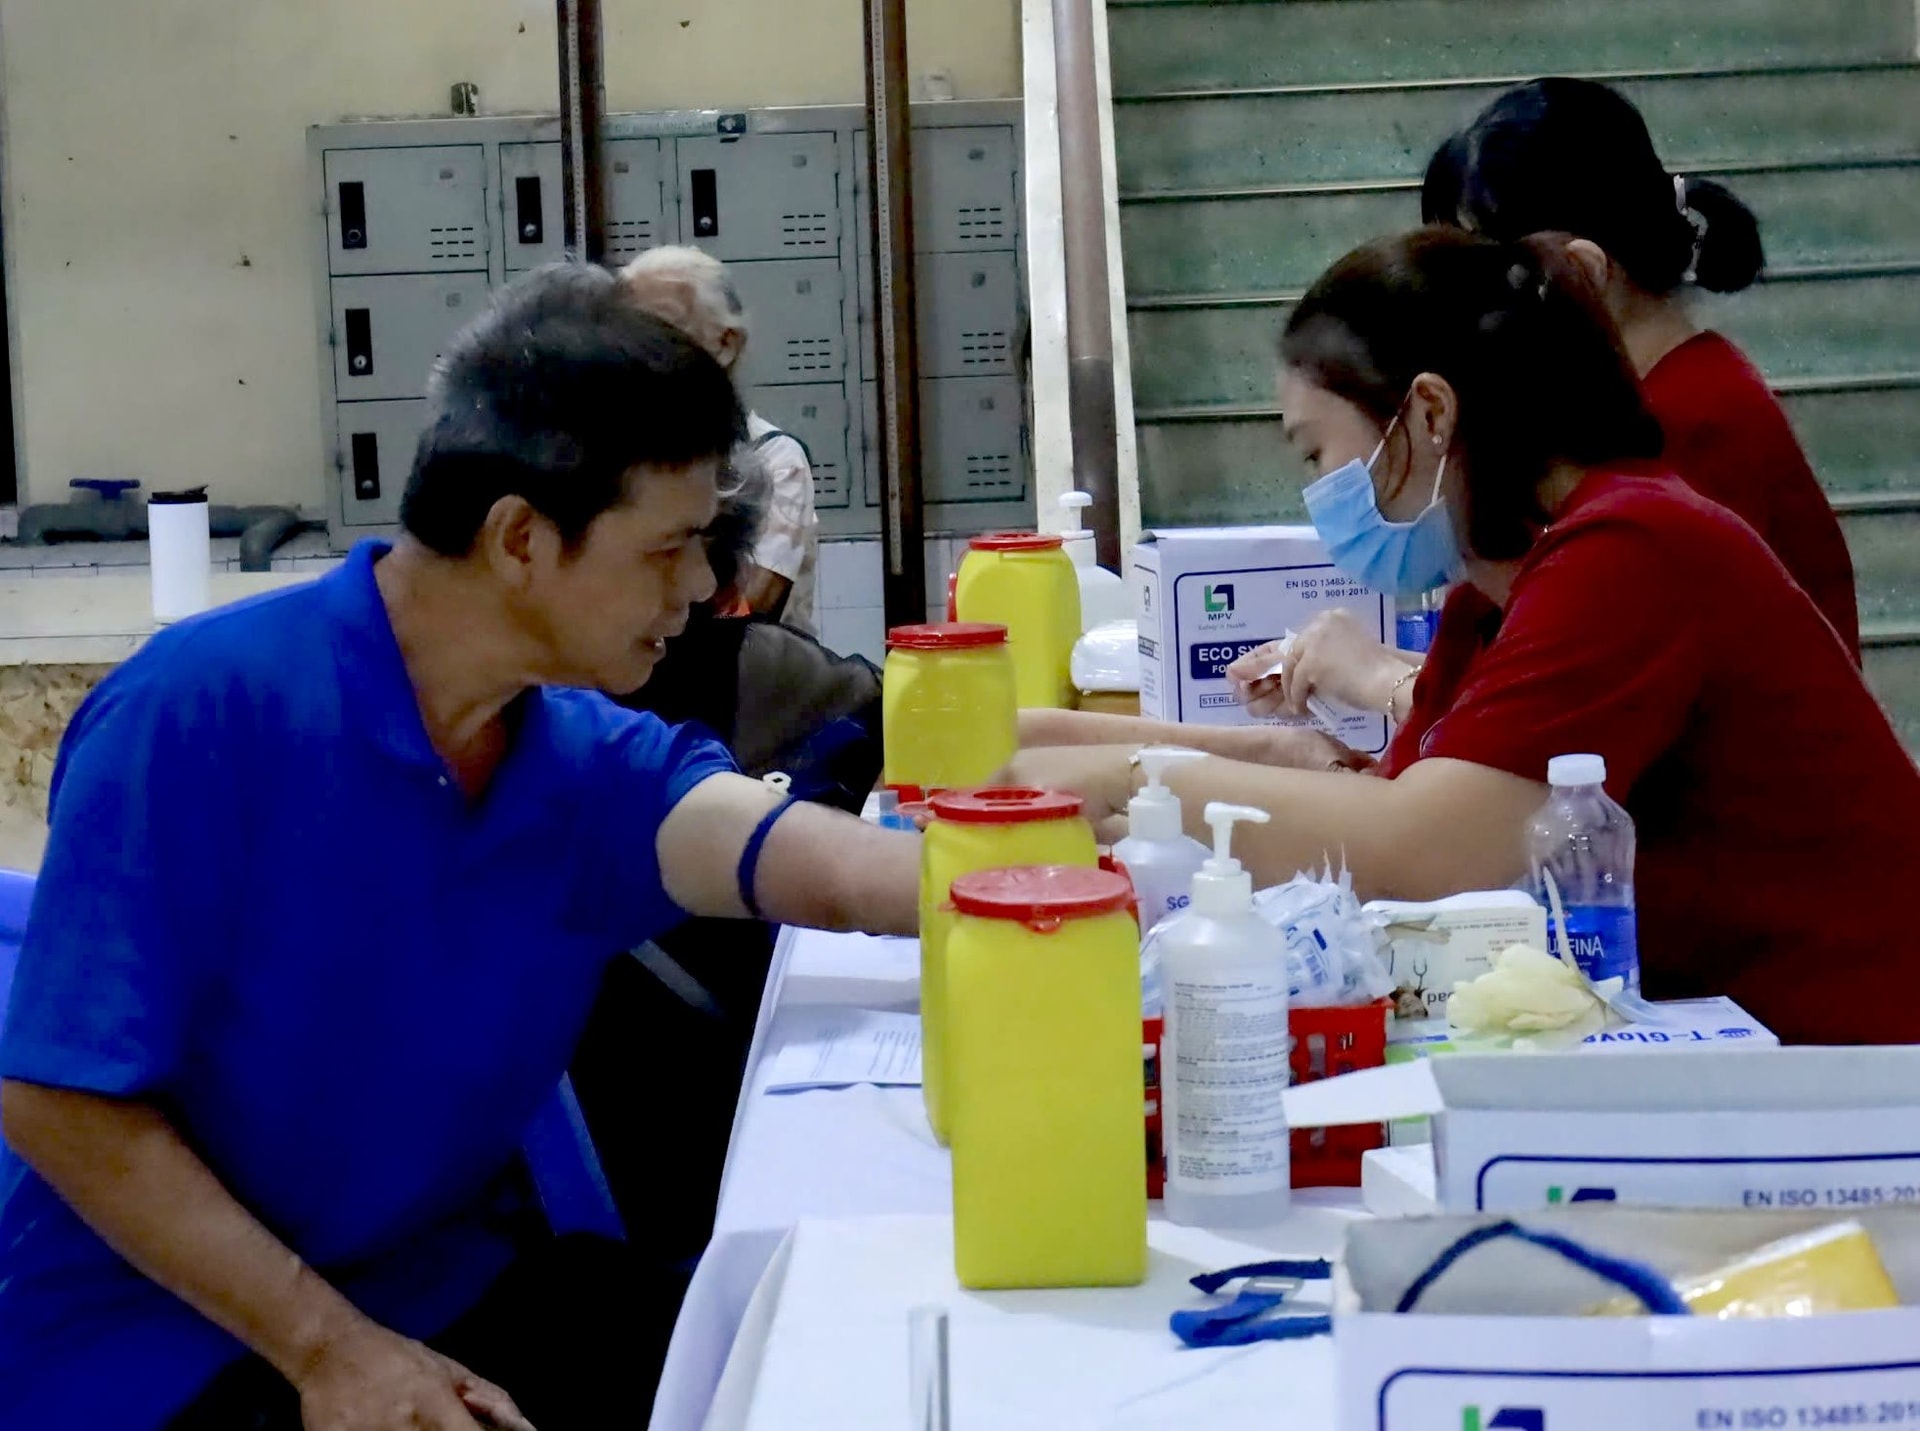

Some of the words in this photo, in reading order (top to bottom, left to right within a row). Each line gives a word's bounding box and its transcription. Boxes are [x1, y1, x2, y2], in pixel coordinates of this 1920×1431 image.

[1286, 580, 1298, 589] EN
[1301, 579, 1317, 588] ISO
[1320, 577, 1357, 587] 13485:2
[1302, 590, 1317, 599] ISO
[1208, 613, 1232, 621] MPV
[1199, 647, 1233, 661] ECO
[1212, 664, 1229, 673] FO
[1166, 895, 1190, 910] SG
[1743, 1189, 1772, 1206] EN
[1779, 1188, 1817, 1206] ISO
[1696, 1406, 1733, 1429] EN
[1741, 1406, 1788, 1428] ISO
